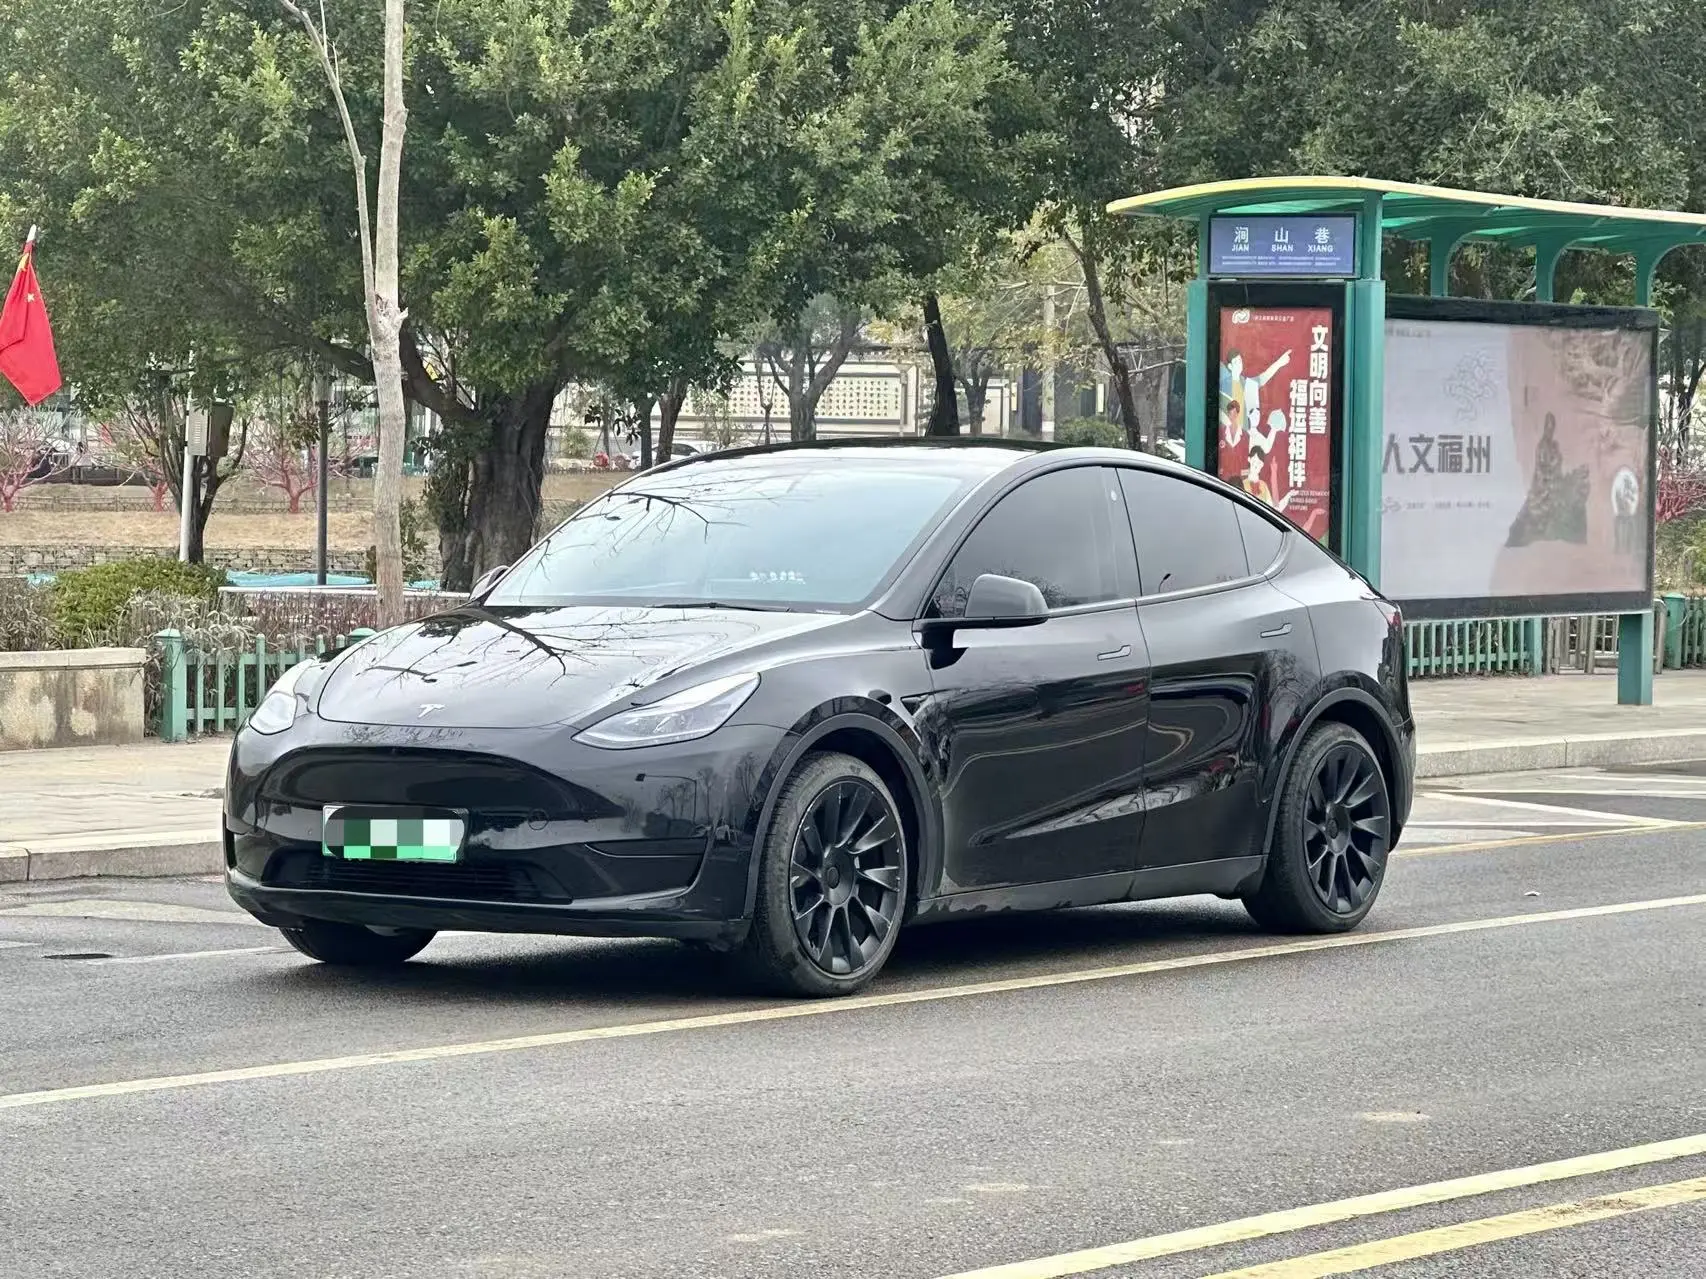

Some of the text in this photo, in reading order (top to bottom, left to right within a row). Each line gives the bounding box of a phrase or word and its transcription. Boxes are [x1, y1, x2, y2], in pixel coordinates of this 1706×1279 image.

[1307, 245, 1334, 253] XIANG
[1309, 325, 1329, 434] 文明向善
[1288, 379, 1308, 488] 福运相伴
[1382, 433, 1491, 474] 人文福州
